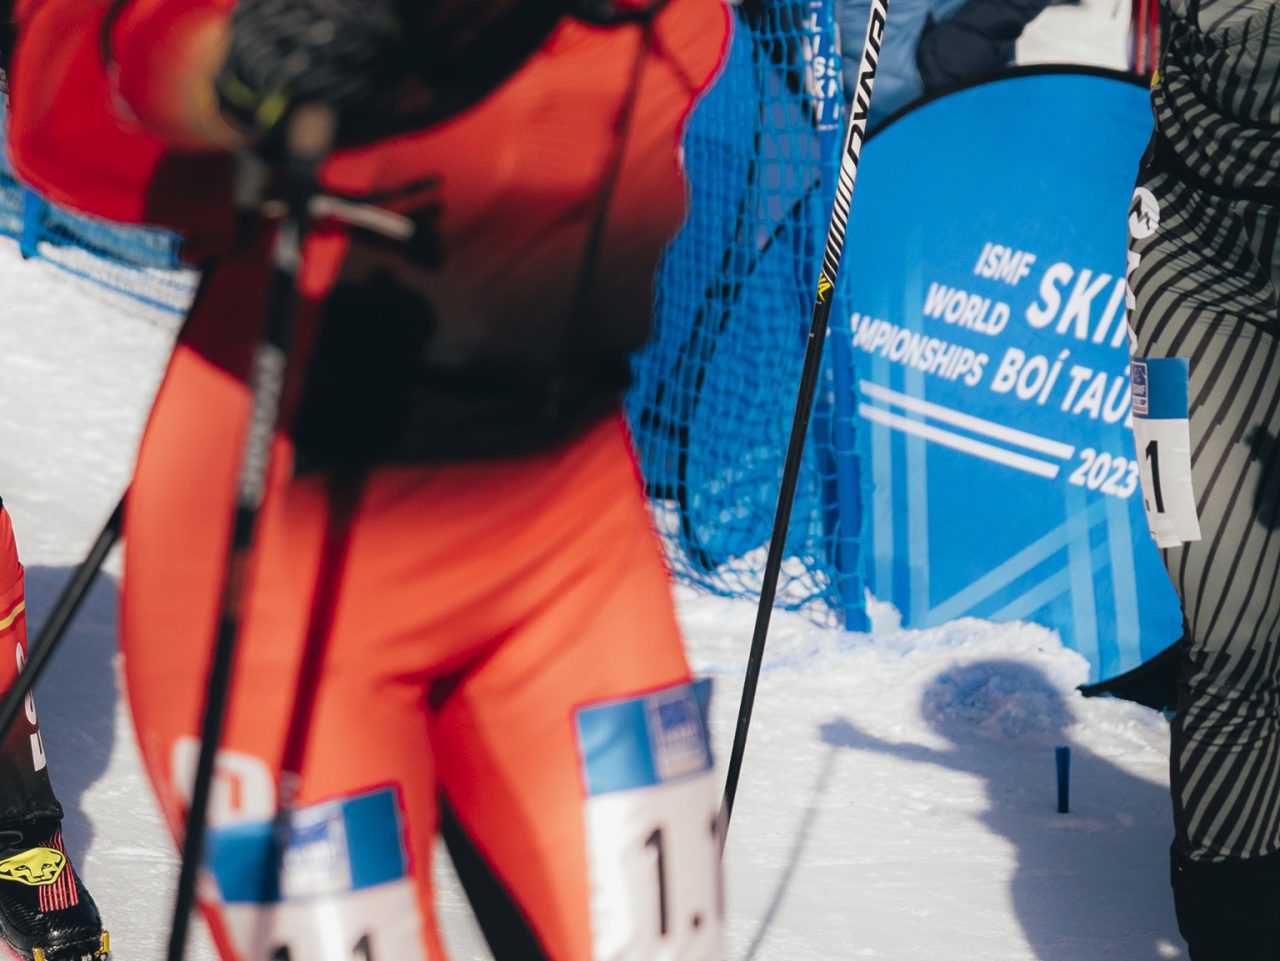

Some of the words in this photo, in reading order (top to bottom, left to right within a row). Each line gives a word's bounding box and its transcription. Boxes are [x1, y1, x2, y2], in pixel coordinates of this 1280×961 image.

[974, 242, 1037, 286] ISMF
[923, 282, 1011, 337] WORLD
[991, 347, 1070, 406] BOÍ
[1068, 447, 1140, 499] 2023
